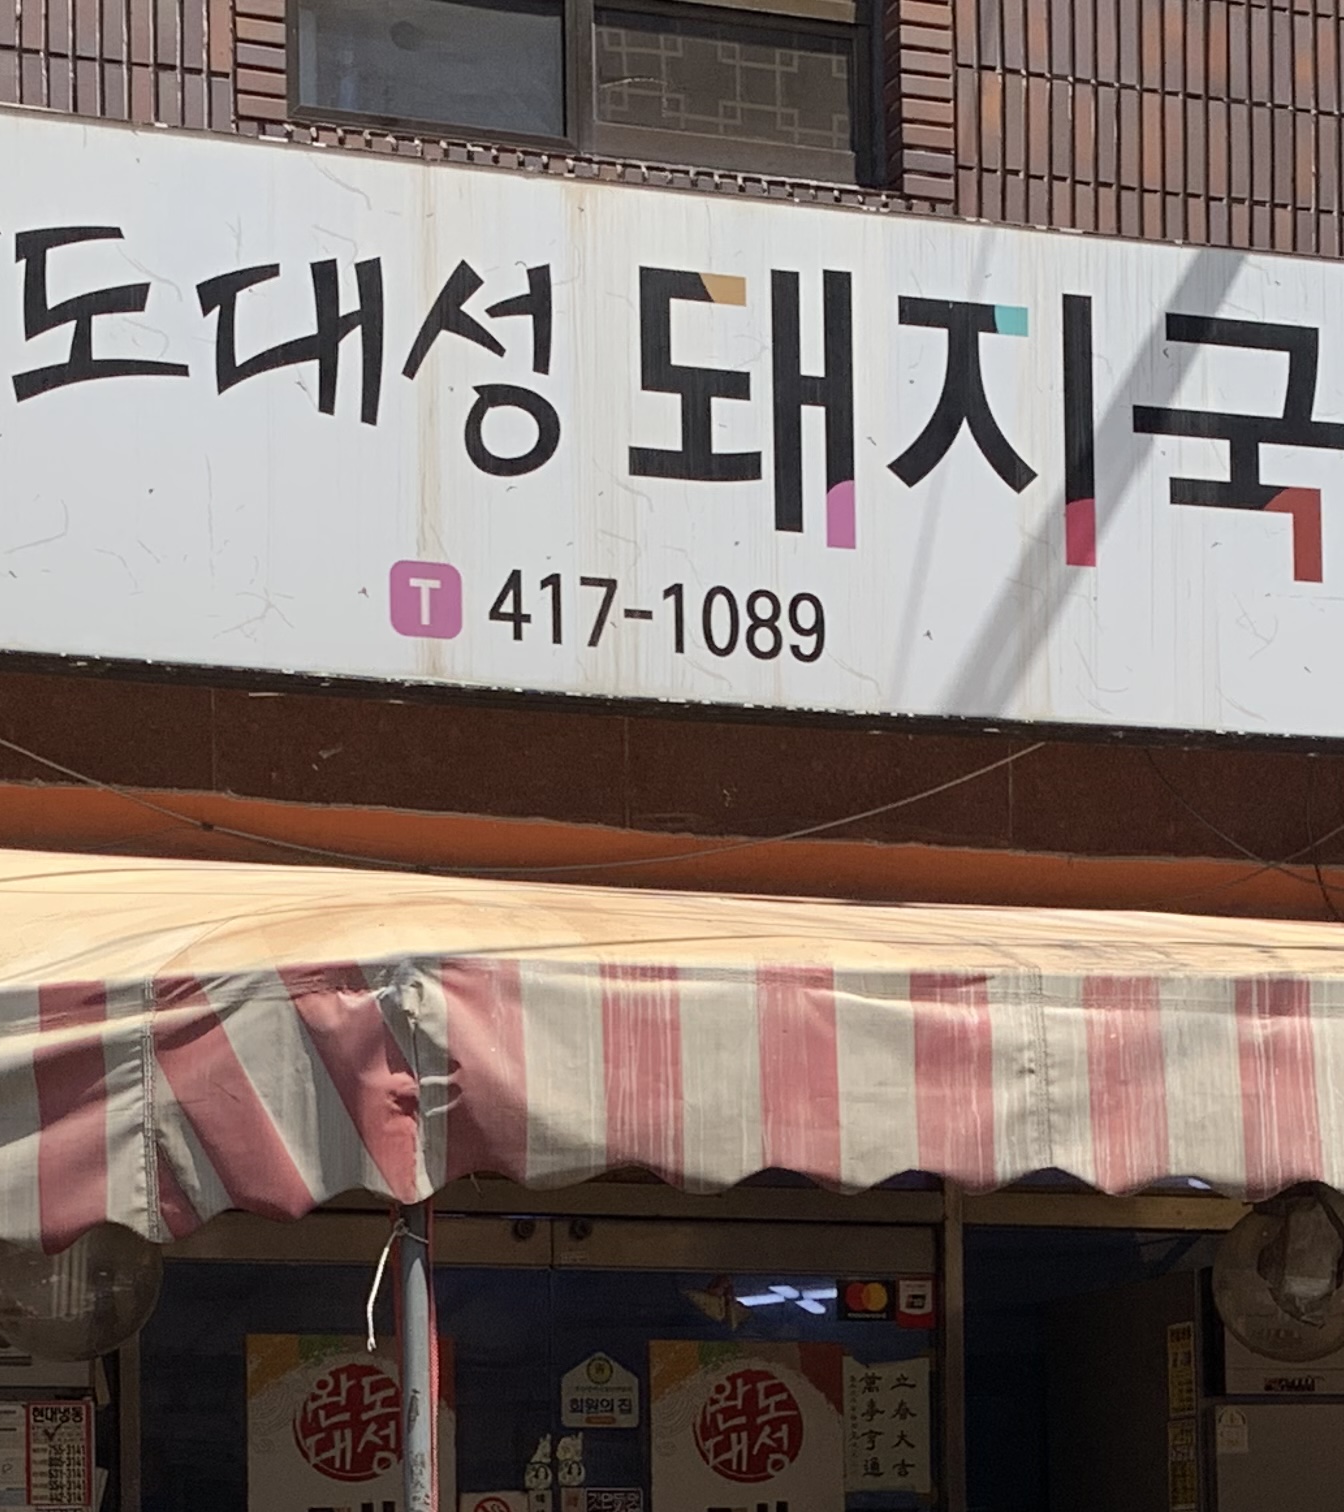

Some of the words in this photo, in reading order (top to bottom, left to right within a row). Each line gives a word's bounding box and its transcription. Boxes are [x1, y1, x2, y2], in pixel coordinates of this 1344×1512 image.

[488, 568, 828, 664] 417-1089
[32, 1406, 84, 1423] 현대냉동
[569, 1397, 614, 1414] 회원의
[617, 1397, 632, 1414] 집
[706, 1378, 798, 1431] 완도
[890, 1373, 917, 1477] 立春大吉
[704, 1424, 791, 1476] 대성
